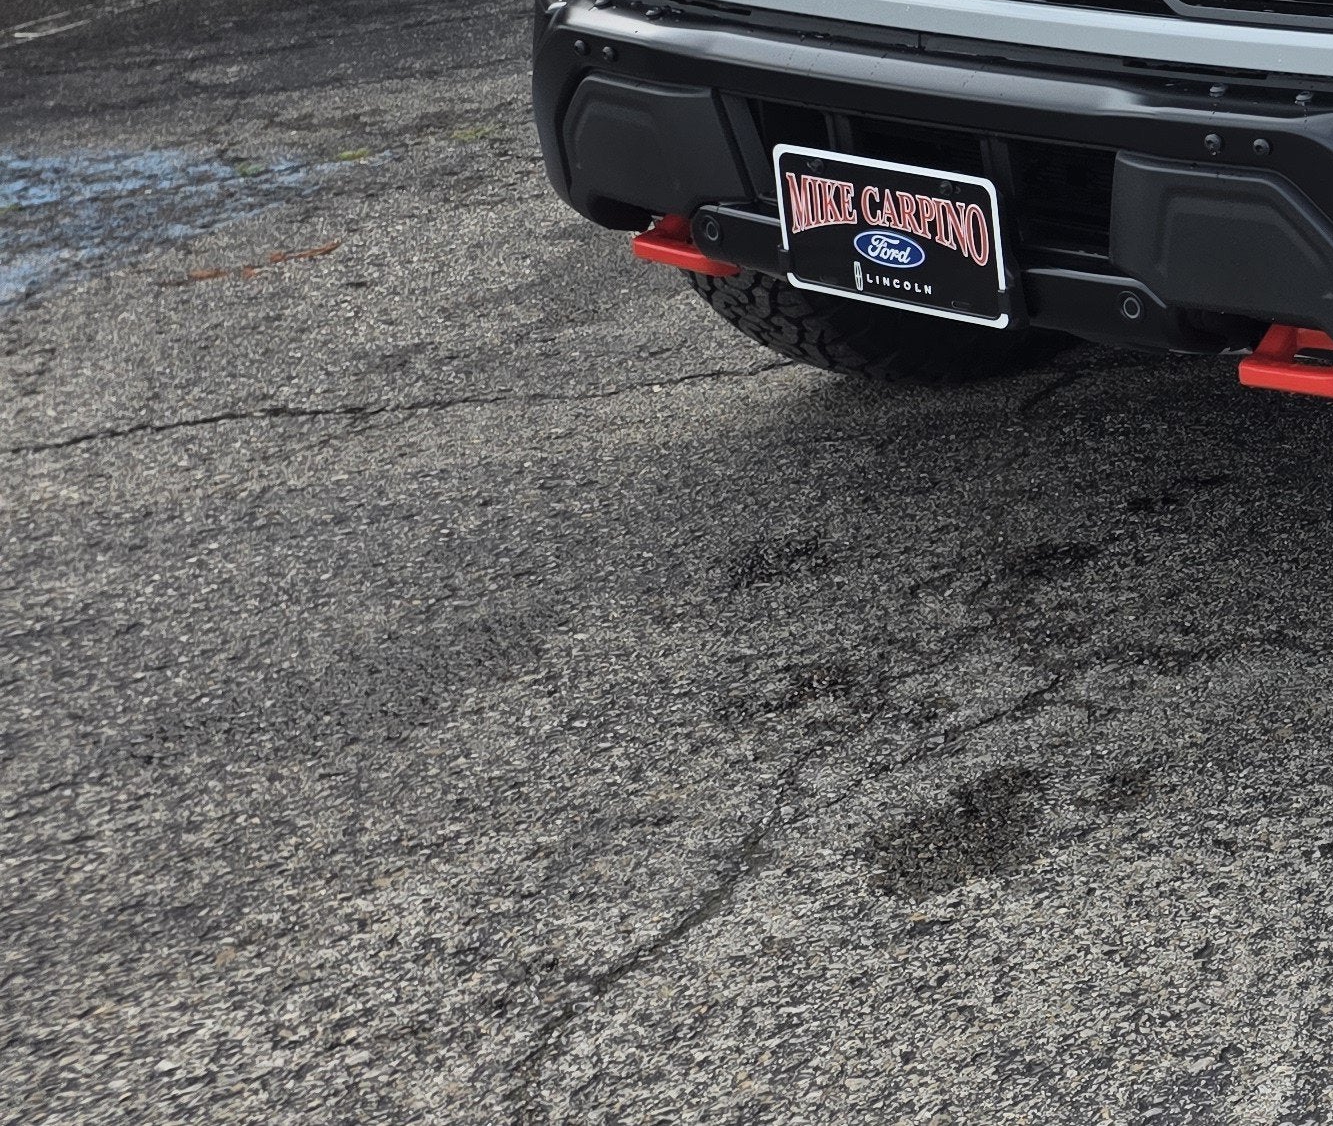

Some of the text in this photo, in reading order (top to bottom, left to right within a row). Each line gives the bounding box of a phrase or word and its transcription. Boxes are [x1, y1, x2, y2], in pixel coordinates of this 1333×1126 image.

[785, 172, 990, 266] MIKE CARPINO
[867, 235, 912, 264] Ford
[866, 274, 933, 295] LINCOLN
